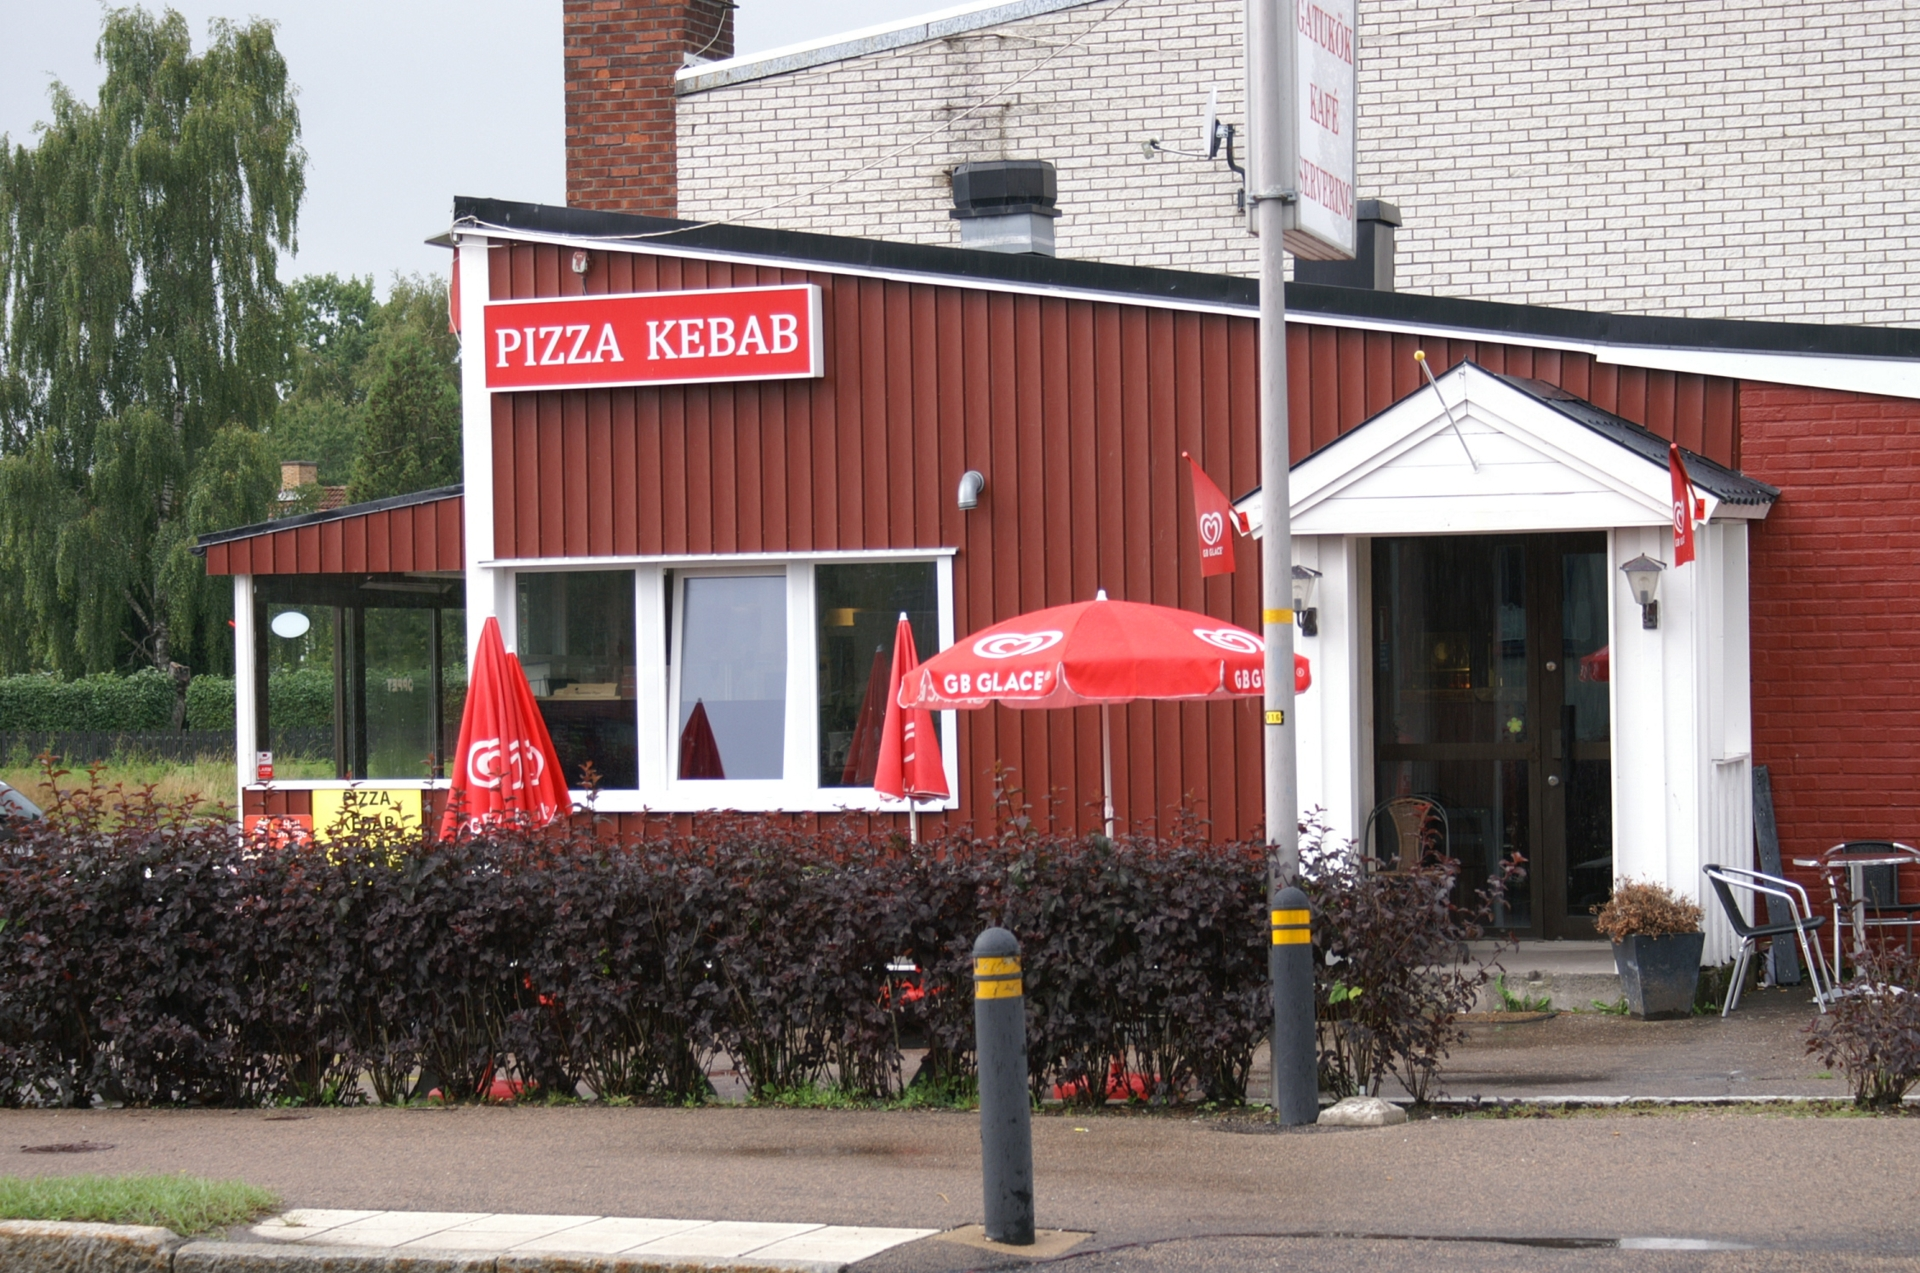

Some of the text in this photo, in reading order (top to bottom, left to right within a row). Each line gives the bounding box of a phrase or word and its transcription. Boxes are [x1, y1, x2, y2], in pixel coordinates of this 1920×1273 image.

[1297, 0, 1352, 65] GATUKÖK
[1310, 82, 1339, 135] KAFÉ
[495, 314, 799, 368] PIZZA KEBAB
[944, 674, 971, 694] GB
[343, 791, 391, 806] PIZZA
